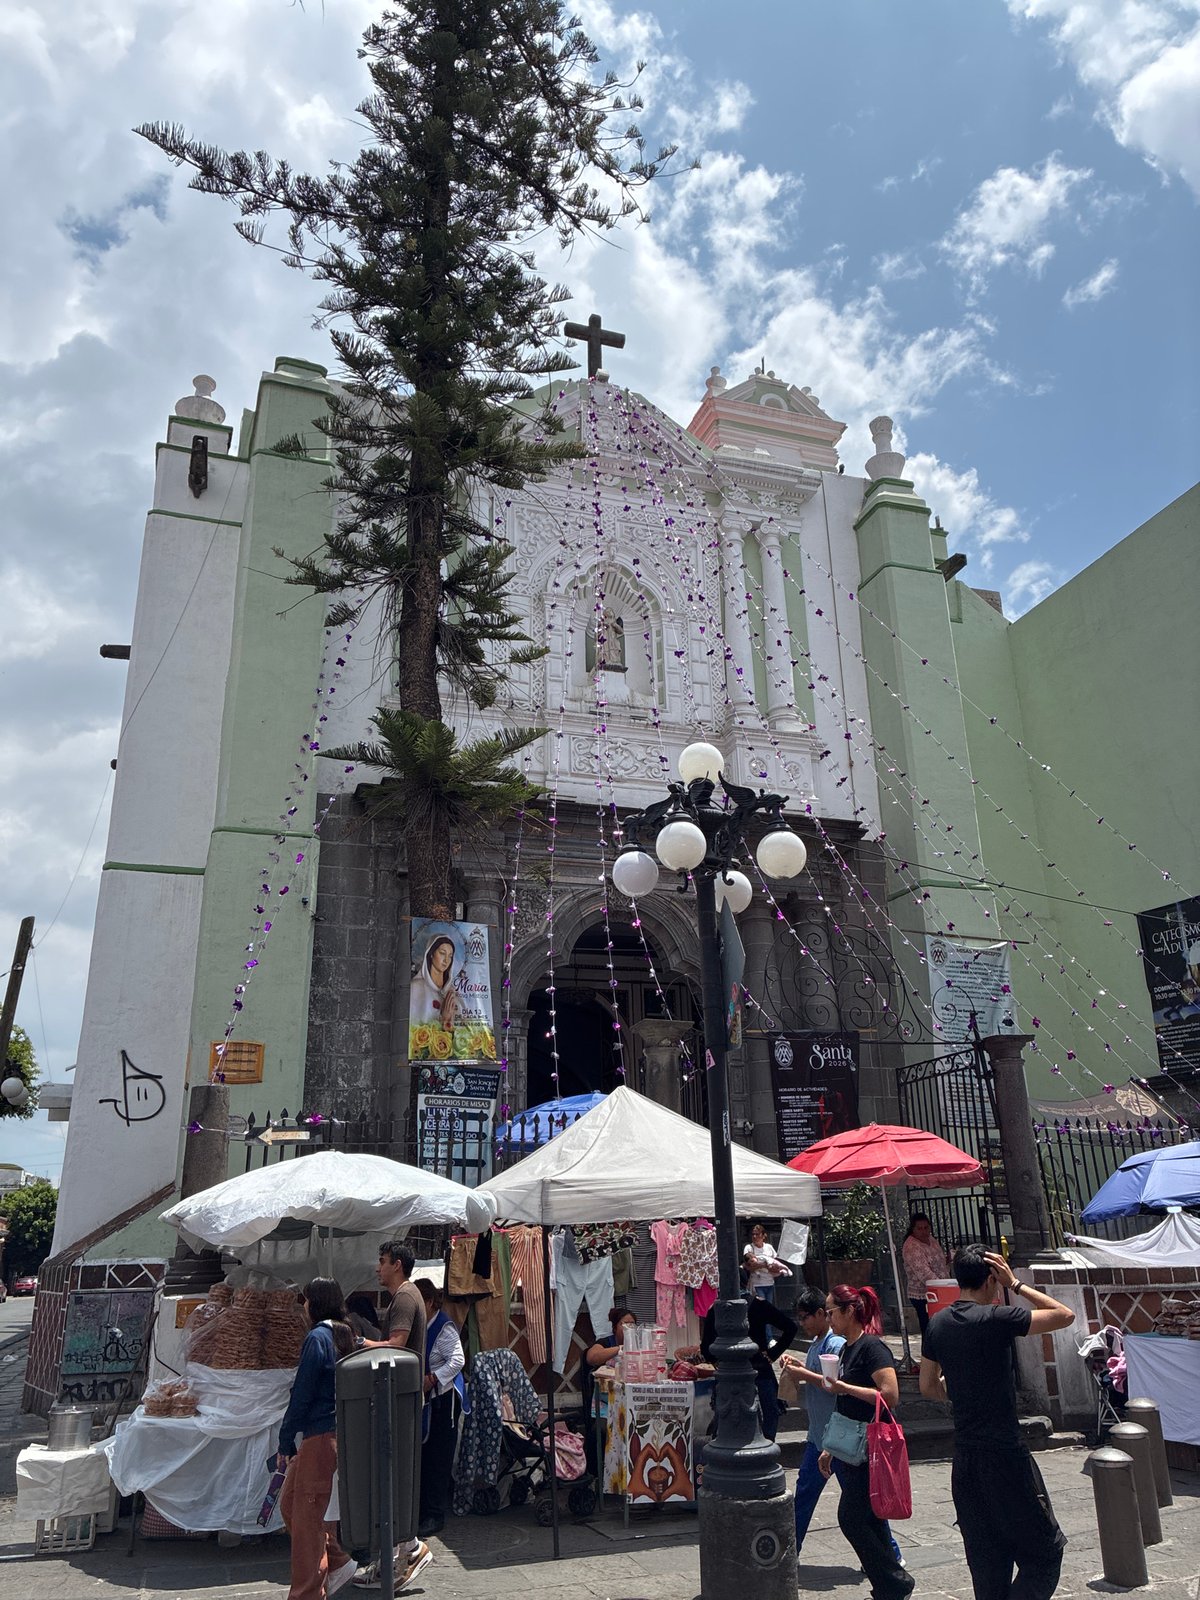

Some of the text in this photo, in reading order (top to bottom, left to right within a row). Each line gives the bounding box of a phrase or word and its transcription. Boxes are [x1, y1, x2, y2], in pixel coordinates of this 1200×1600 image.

[1163, 937, 1200, 955] ADULT
[1153, 982, 1182, 993] DOMINOS
[428, 1098, 460, 1107] HORARIOS
[428, 1120, 460, 1128] CERAO
